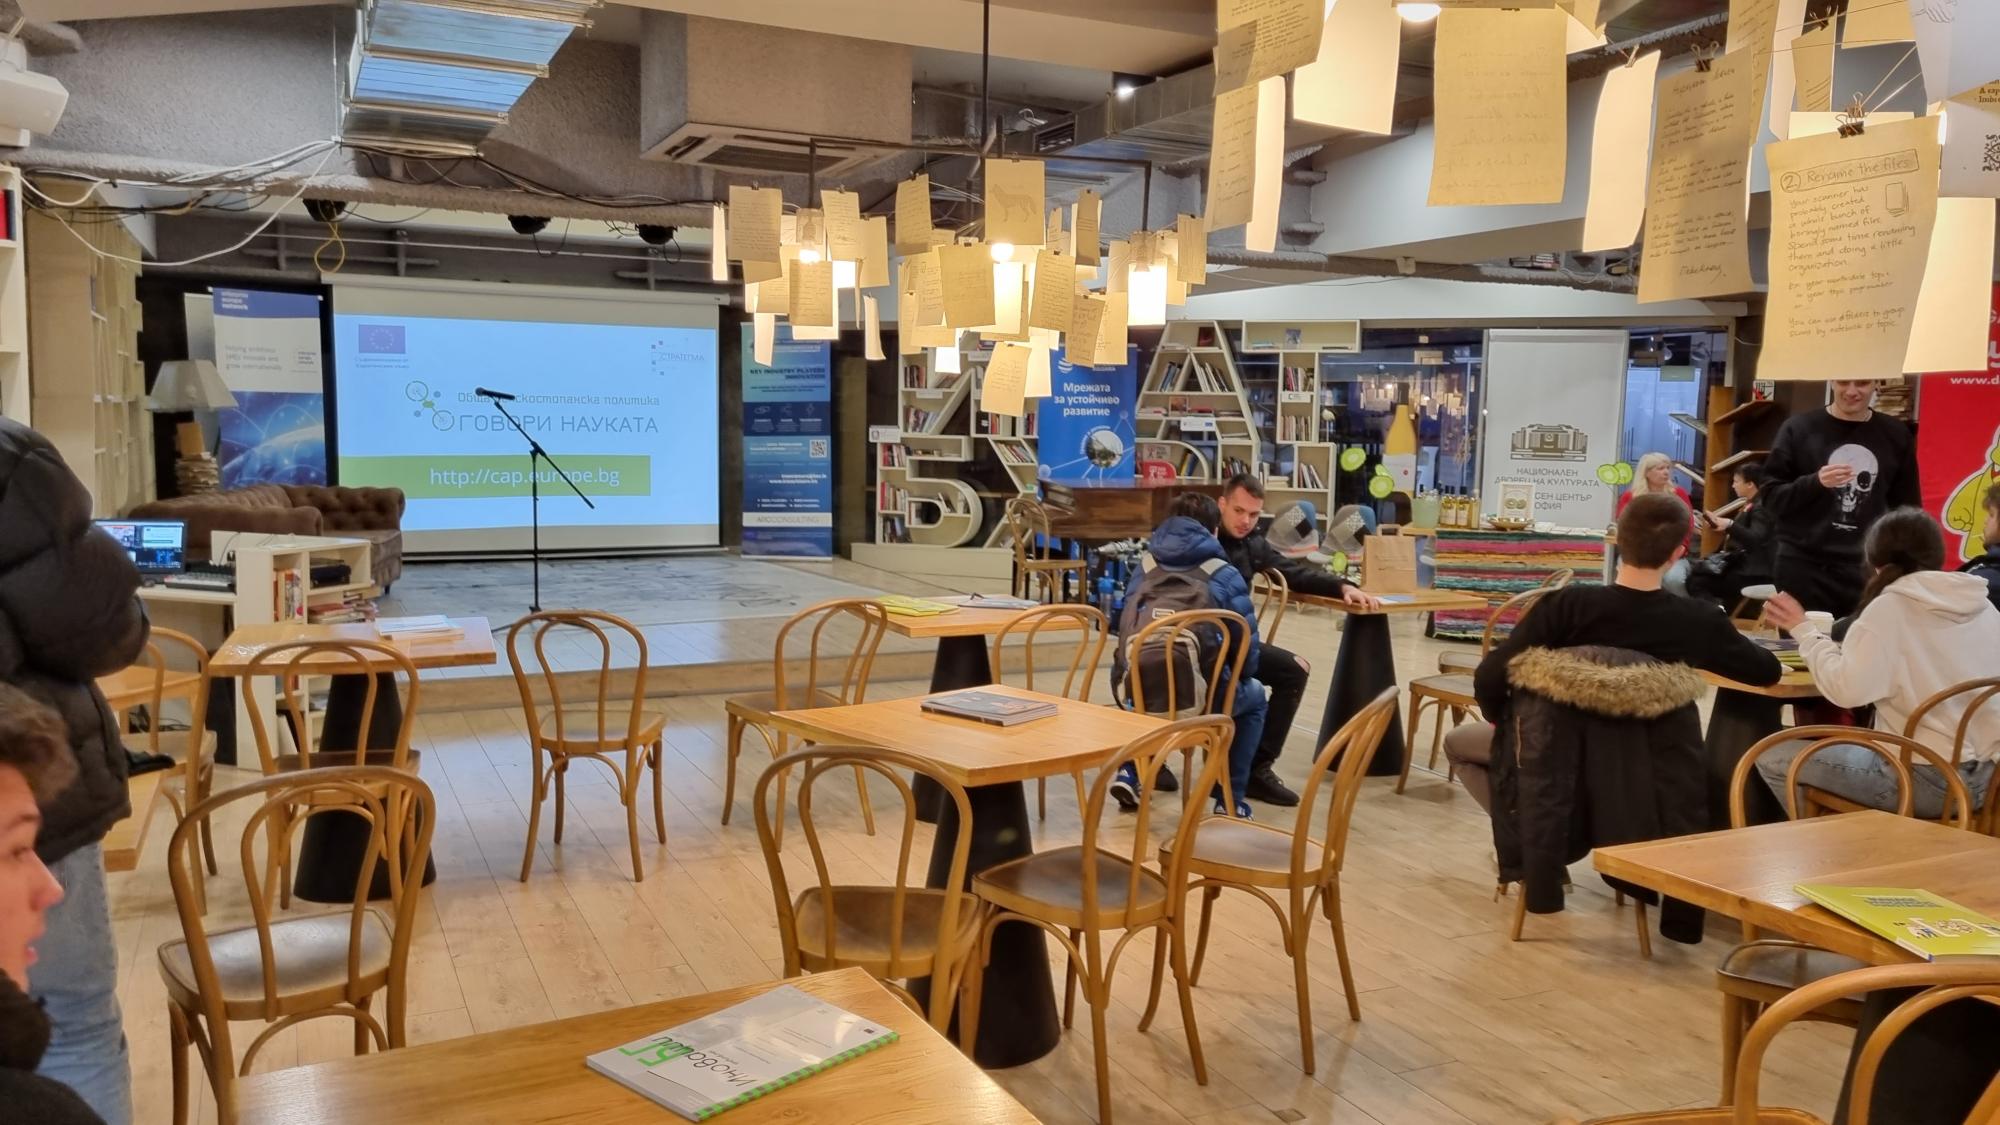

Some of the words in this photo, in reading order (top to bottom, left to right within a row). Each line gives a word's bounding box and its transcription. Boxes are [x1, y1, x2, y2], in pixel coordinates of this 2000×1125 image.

[1807, 169, 1853, 182] Rename
[1857, 162, 1879, 175] the
[1884, 157, 1908, 169] files
[1839, 244, 1866, 257] doing
[1063, 382, 1111, 393] Мрежата
[1054, 396, 1065, 404] за
[1067, 394, 1120, 406] устойчиво
[1063, 407, 1110, 417] развитие
[460, 414, 551, 432] ГОВОРИ
[561, 416, 659, 433] НАУКАТА
[430, 467, 620, 487] http://cap.europe.bg
[1516, 468, 1578, 477] НАЦИОНАЛЕН
[1546, 479, 1600, 487] КУЛТУРАТА
[1556, 492, 1592, 502] ЦЕНТЪР
[1534, 501, 1562, 510] ОФИЯ
